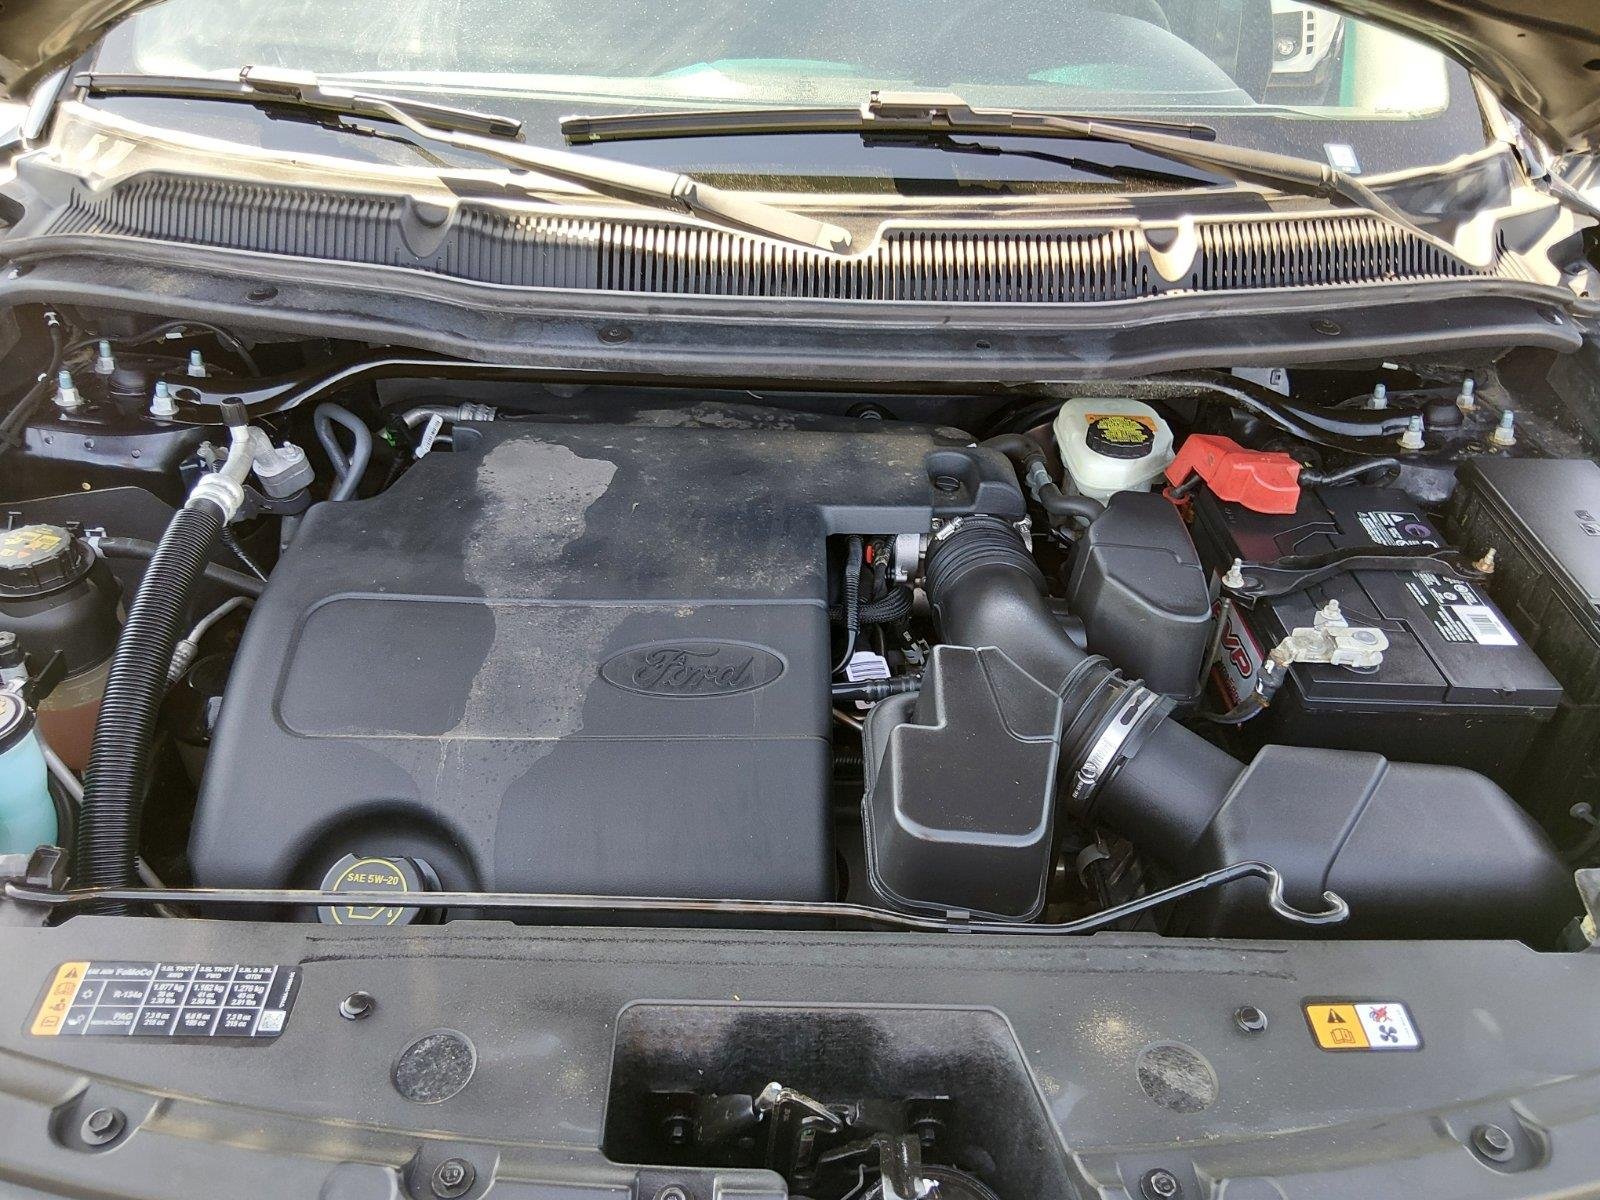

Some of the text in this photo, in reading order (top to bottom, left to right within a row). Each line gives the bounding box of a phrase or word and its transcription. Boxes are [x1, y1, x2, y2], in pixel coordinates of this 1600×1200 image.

[632, 648, 755, 689] Ford
[347, 872, 399, 885] SAE 5W-20
[115, 968, 153, 976] FoMoCo
[174, 983, 185, 993] kg
[214, 984, 225, 994] kg
[254, 985, 265, 994] kg
[112, 990, 144, 998] R-134a
